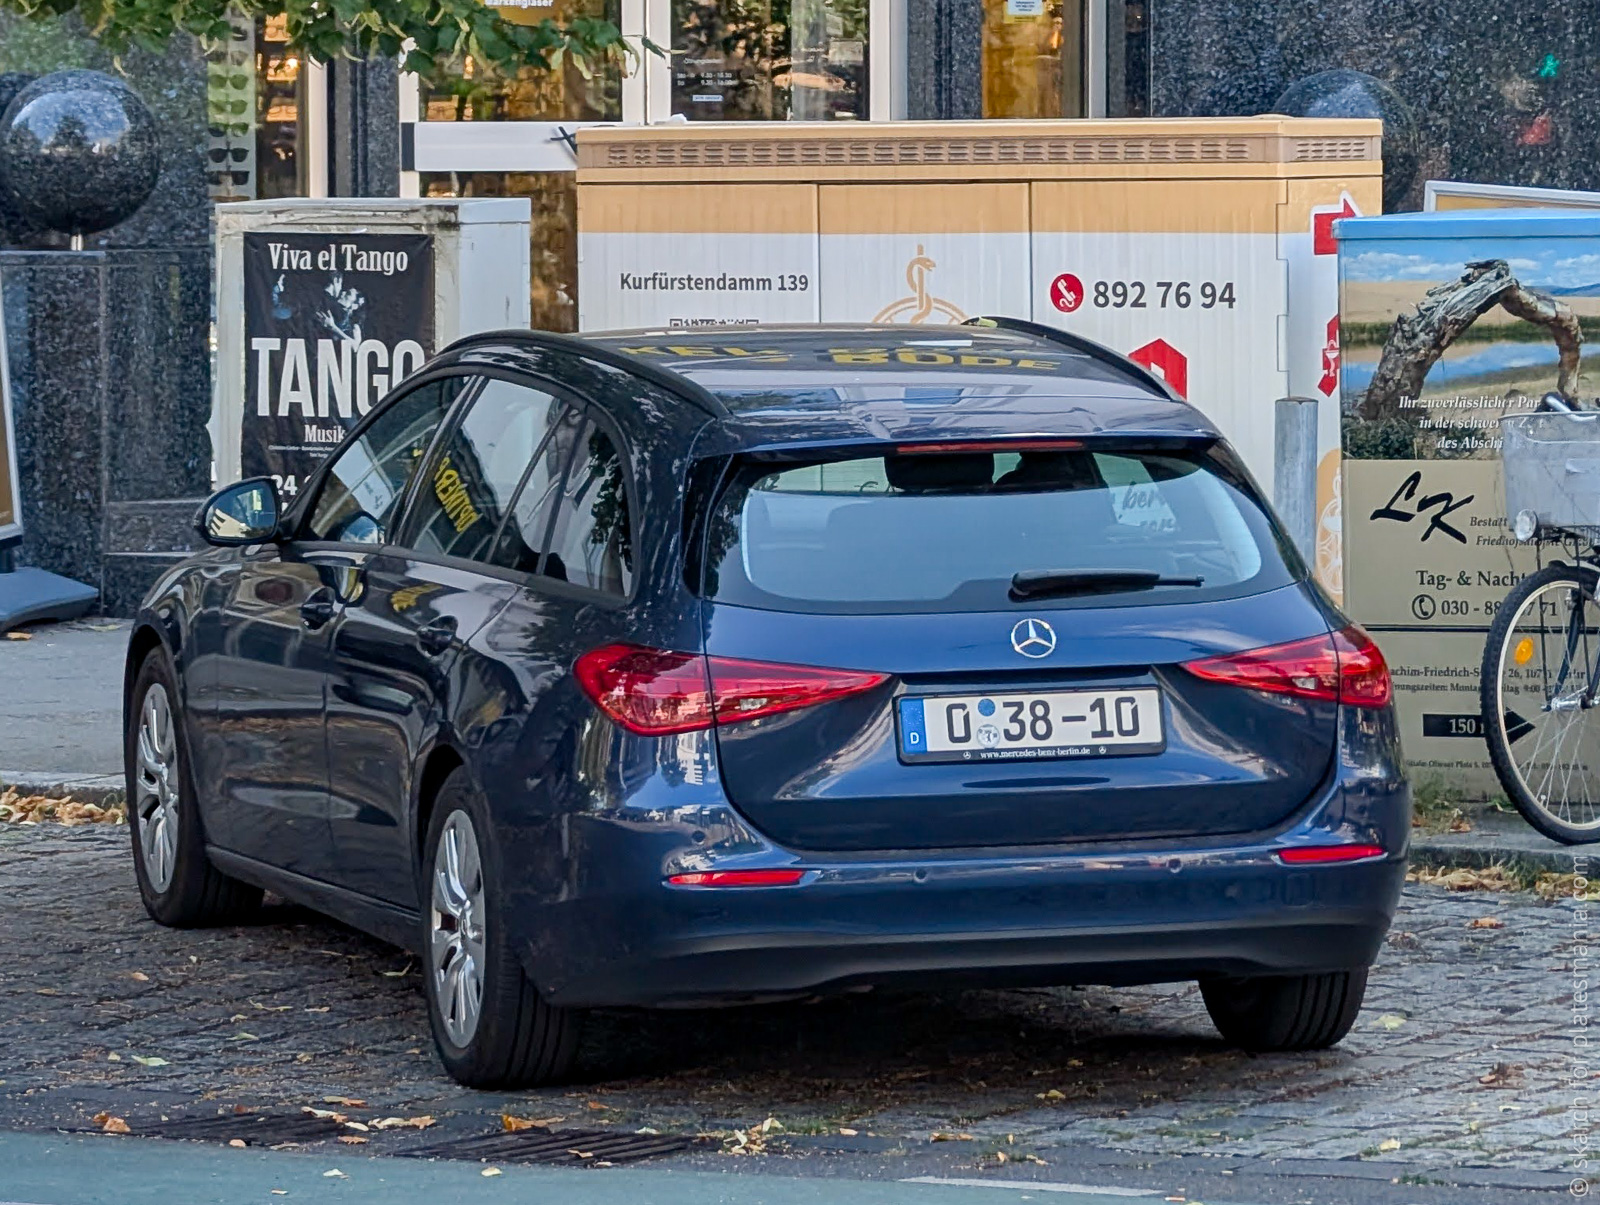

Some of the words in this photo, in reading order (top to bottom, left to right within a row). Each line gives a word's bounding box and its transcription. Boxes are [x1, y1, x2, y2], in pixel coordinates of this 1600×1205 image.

[267, 243, 313, 270] Viva
[317, 244, 337, 271] el
[341, 244, 409, 276] Tango
[619, 272, 773, 292] Kurfürstendamm
[777, 274, 809, 292] 139
[1093, 281, 1147, 309] 892
[1156, 281, 1191, 309] 76
[1200, 282, 1236, 309] 94
[1398, 396, 1418, 409] Ihr
[1420, 396, 1515, 409] zuverlässlicher
[1419, 416, 1433, 429] in
[1434, 416, 1454, 429] der
[304, 424, 347, 443] Musik
[1437, 436, 1458, 449] des
[1415, 570, 1452, 591] Tag-
[1456, 570, 1472, 586] &
[1441, 600, 1469, 615] 030
[1449, 718, 1477, 734] 150
[910, 732, 919, 744] D
[980, 747, 1091, 759] www.mercedes-benz-berlin.de
